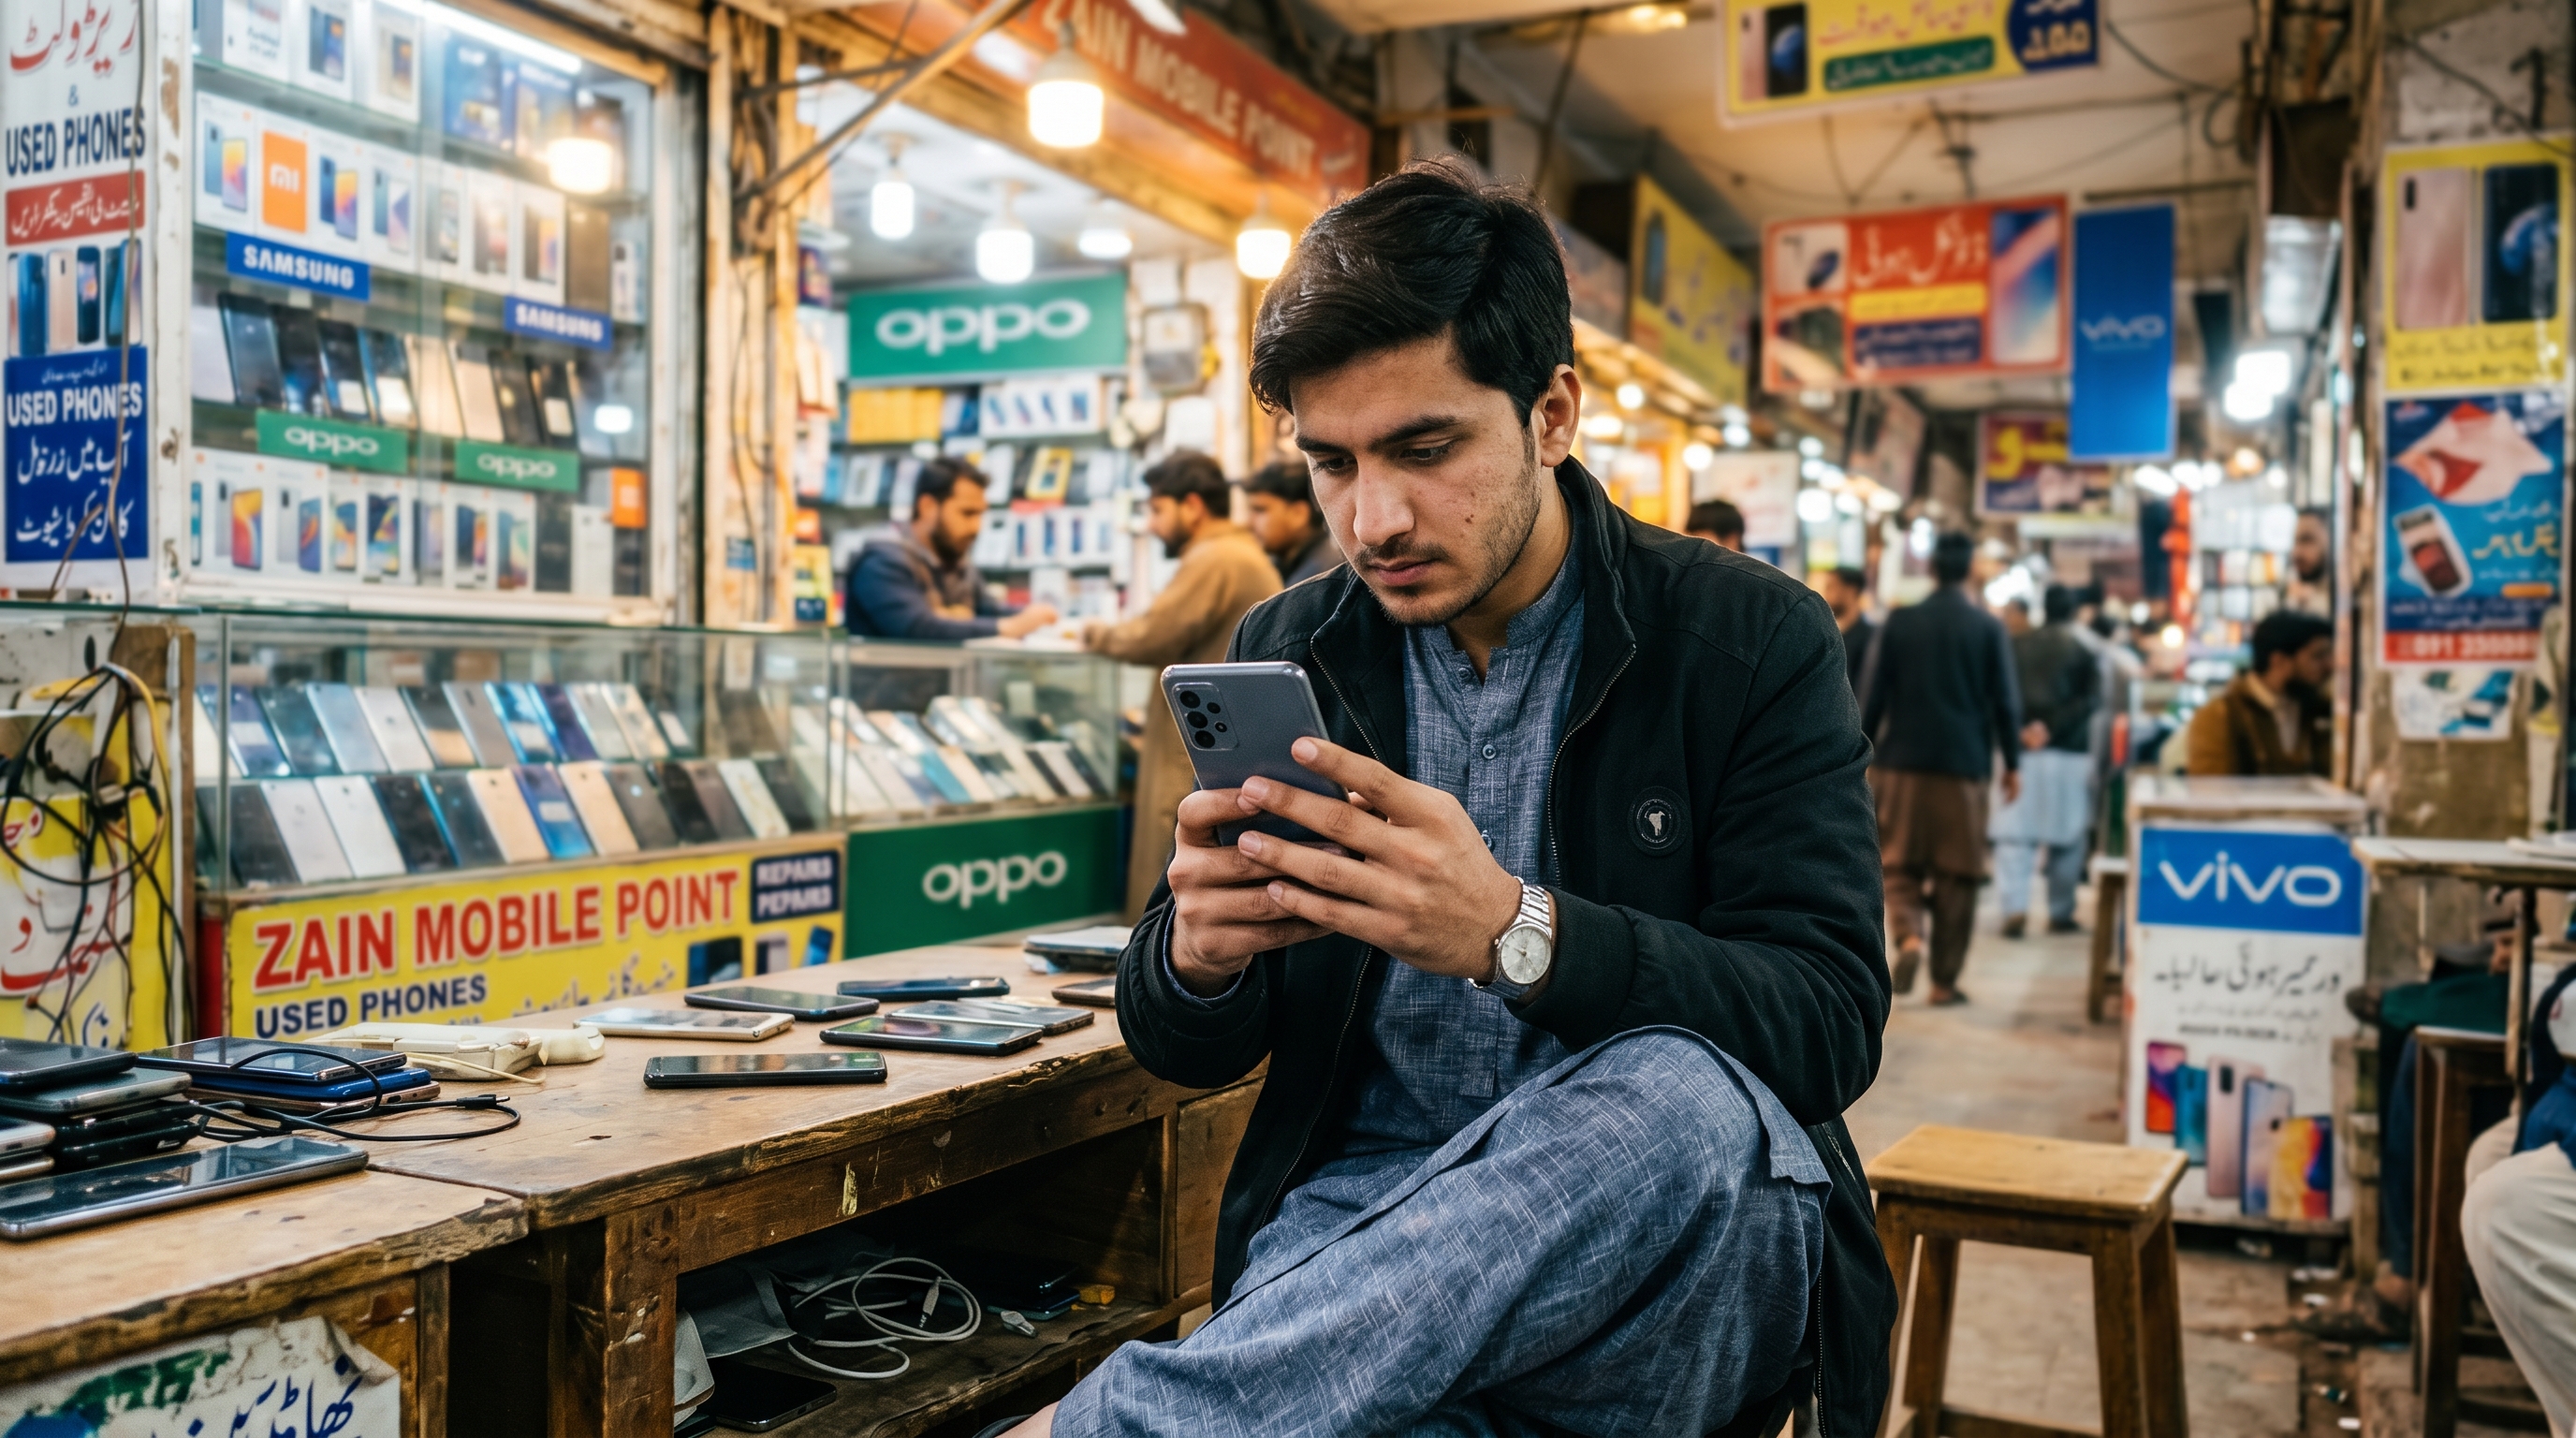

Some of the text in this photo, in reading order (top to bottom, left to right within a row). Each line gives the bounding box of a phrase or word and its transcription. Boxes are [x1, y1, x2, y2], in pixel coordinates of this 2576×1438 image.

[1134, 34, 1240, 139] MOBILE
[7, 106, 145, 178] USED PHONES
[243, 243, 355, 290] SAMSUNG
[516, 303, 603, 342] SAMSUNG
[7, 381, 142, 428] USED PHONES
[756, 856, 832, 888] REPAIRS
[254, 870, 739, 990] ZAIN MOBILE POINT
[256, 996, 347, 1039] USED
[360, 974, 487, 1022] PHONES
